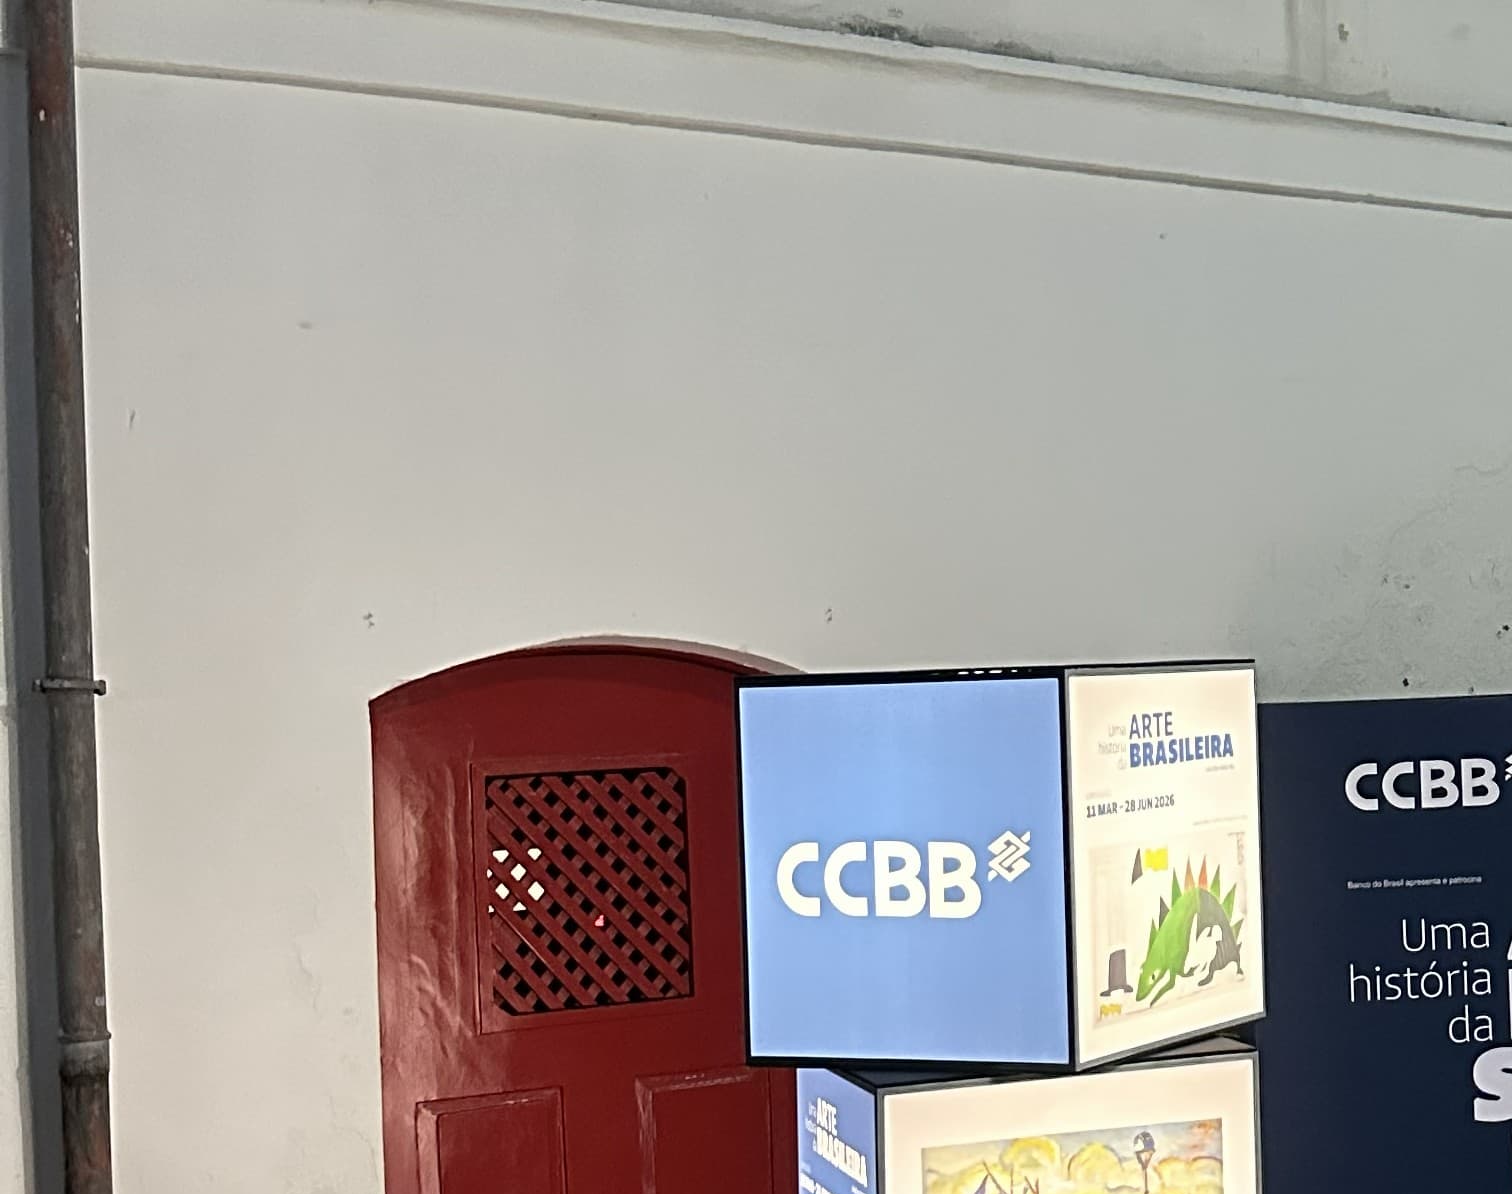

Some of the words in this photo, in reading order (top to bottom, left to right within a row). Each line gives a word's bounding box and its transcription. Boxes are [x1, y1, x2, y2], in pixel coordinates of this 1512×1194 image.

[1129, 711, 1174, 740] ARTE
[1129, 733, 1234, 768] BRASILEIRA
[1344, 756, 1500, 811] CCBB
[1086, 805, 1097, 818] 11
[1098, 801, 1118, 816] MAR
[1125, 800, 1136, 813] 28
[1137, 797, 1153, 811] JUN
[1154, 794, 1175, 809] 2026
[776, 840, 983, 919] CCBB
[1402, 918, 1490, 952] Uma
[1349, 961, 1492, 1002] história
[1448, 1005, 1493, 1043] da
[816, 1097, 838, 1136] ARTE
[816, 1126, 868, 1188] BRASILEIRA
